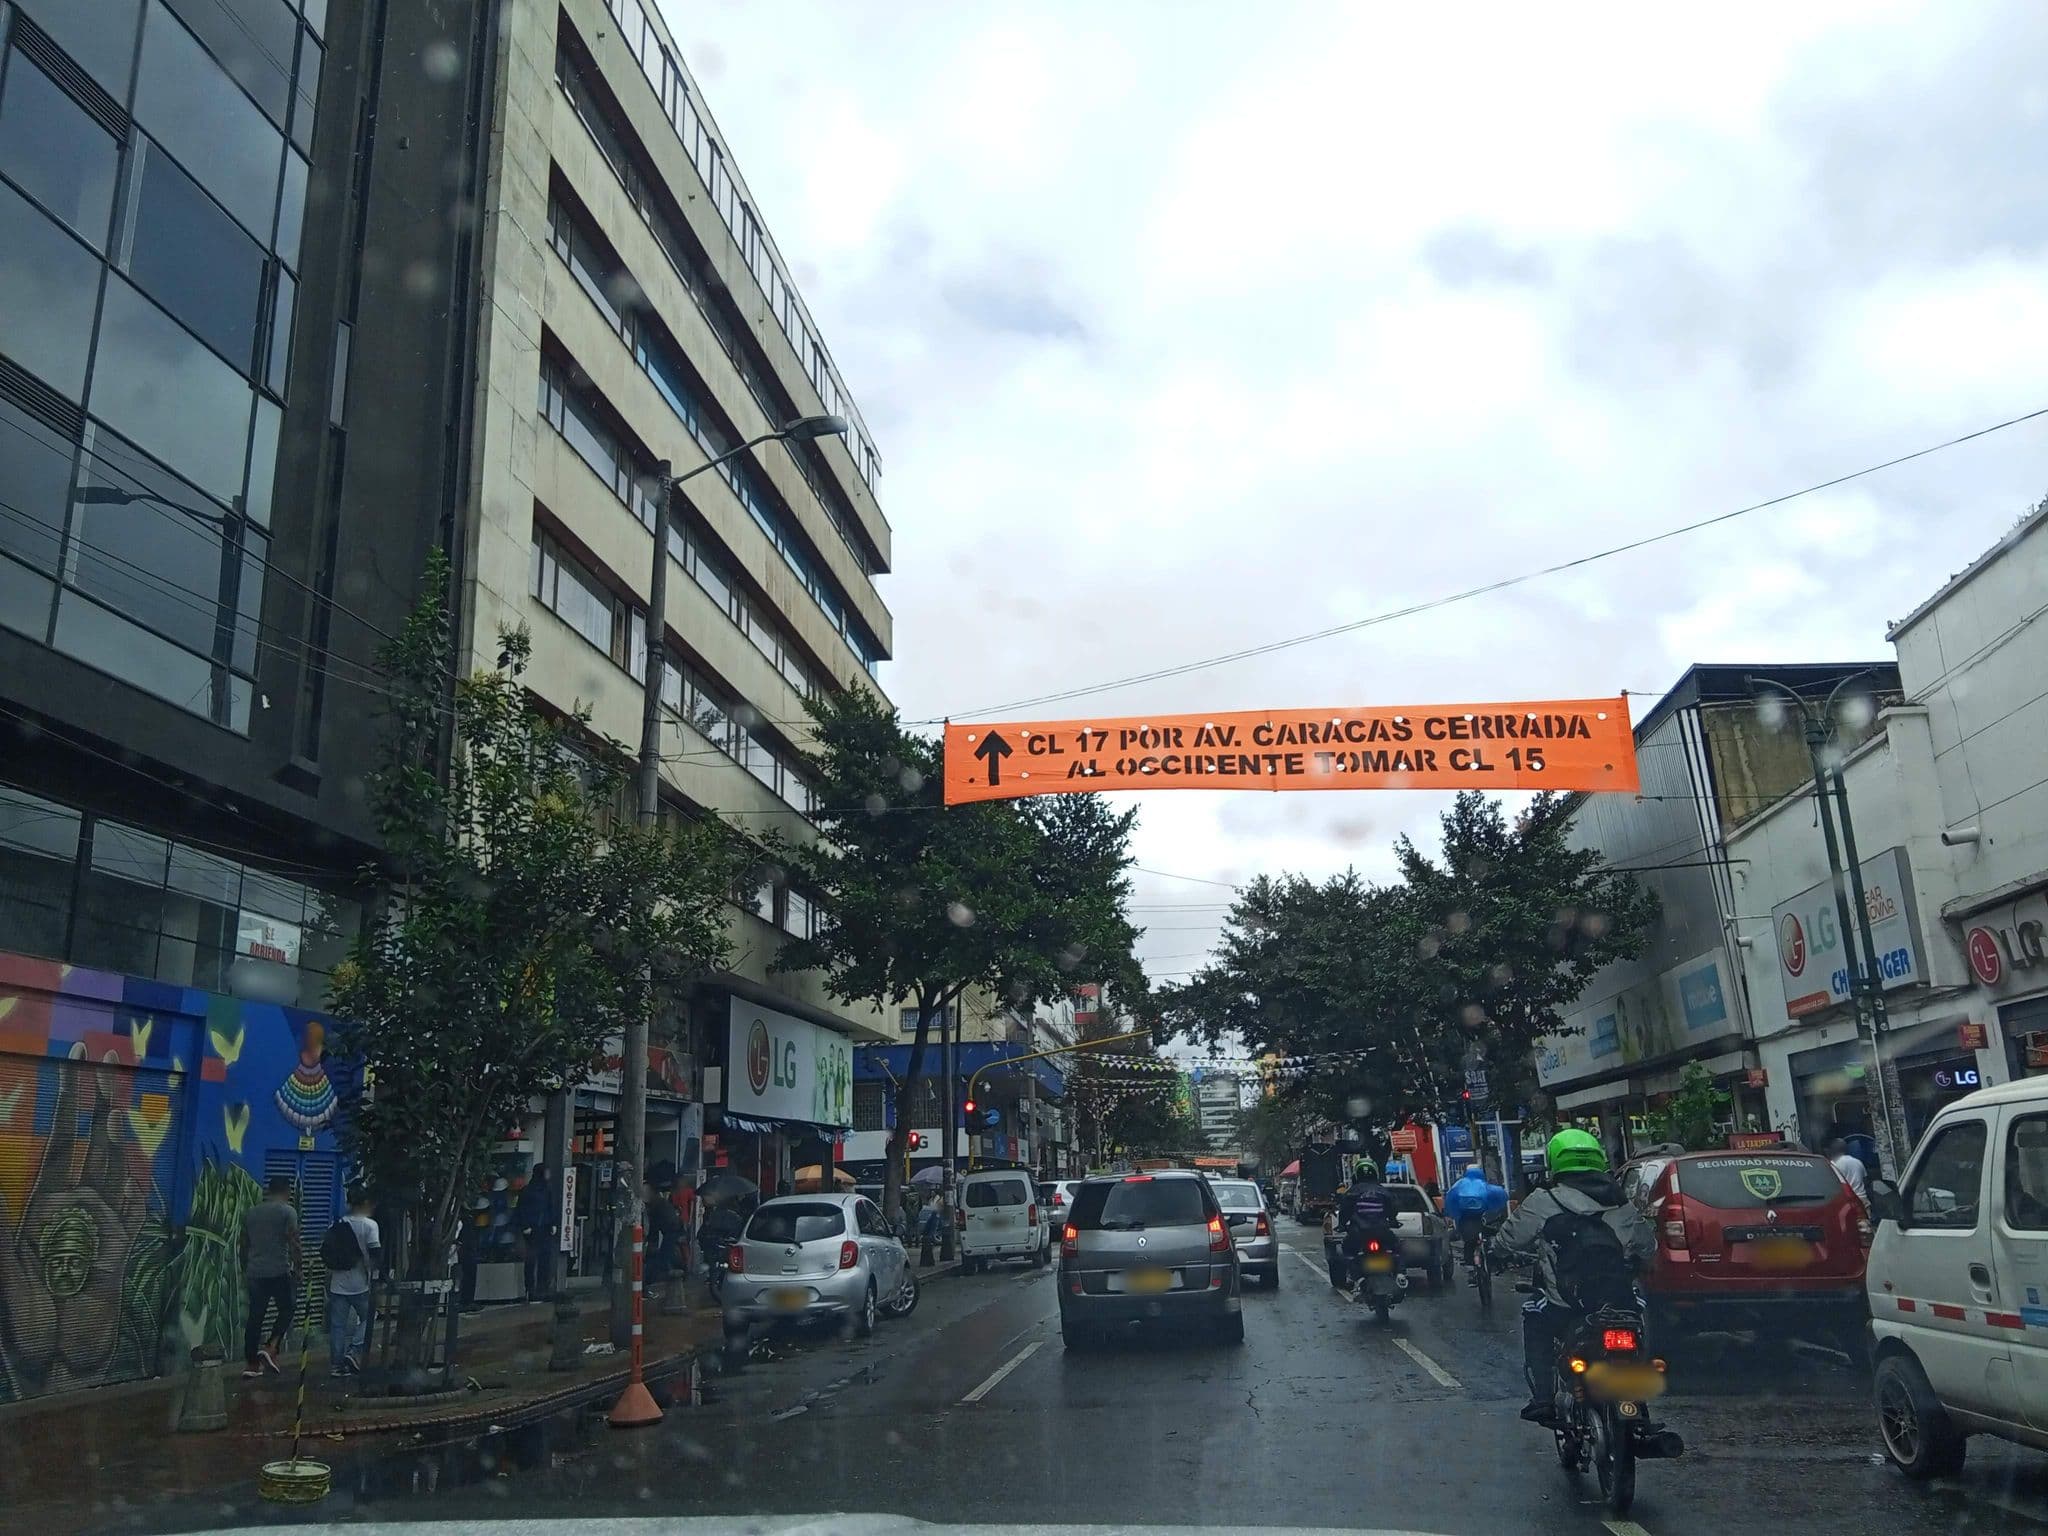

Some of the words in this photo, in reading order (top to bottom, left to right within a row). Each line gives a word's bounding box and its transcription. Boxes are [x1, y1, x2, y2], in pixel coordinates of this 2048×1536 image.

[1027, 734, 1064, 755] CL
[1075, 731, 1109, 753] 17
[1119, 727, 1184, 750] POR
[1193, 725, 1242, 748] AV.
[1253, 716, 1414, 746] CARACAS
[1424, 713, 1592, 742] CERRADA
[1067, 759, 1108, 779] AL
[1116, 752, 1305, 777] OCCIDENTE
[1314, 748, 1439, 773] TOMAR
[1449, 747, 1494, 771] CL
[1505, 746, 1546, 772] 15
[1805, 906, 1837, 956] LG
[250, 942, 286, 962] ARRIENDA
[774, 1036, 796, 1090] LG
[1954, 1070, 1978, 1085] LG
[917, 1135, 928, 1149] G
[1696, 1159, 1762, 1169] SEGURIDAD
[1765, 1159, 1814, 1168] PRIVADA
[563, 1175, 574, 1242] Overoles
